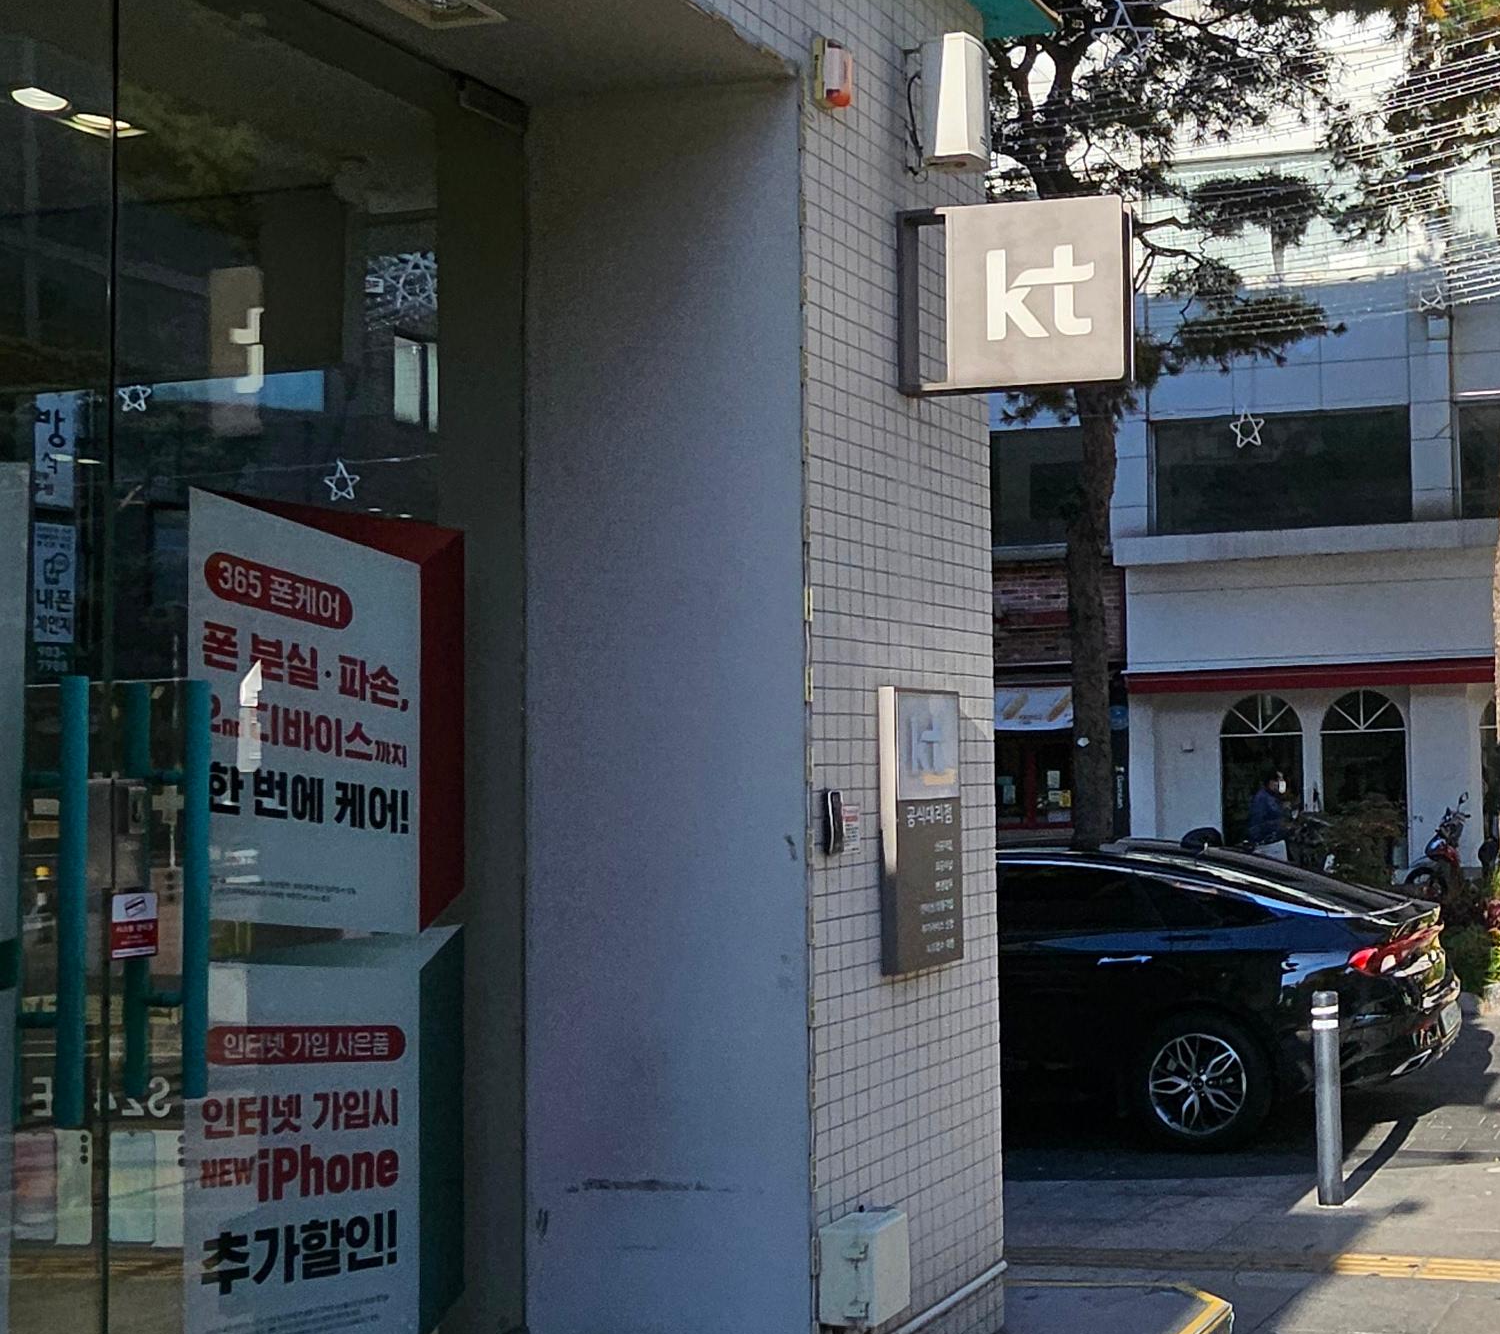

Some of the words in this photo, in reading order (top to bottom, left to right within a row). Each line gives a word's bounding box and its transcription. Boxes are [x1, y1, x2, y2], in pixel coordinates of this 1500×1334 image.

[986, 243, 1095, 341] kt
[217, 560, 263, 600] 365
[269, 573, 342, 623] 폰케어
[202, 620, 239, 672] 폰
[209, 761, 244, 815] 한
[253, 770, 325, 824] 번에
[334, 780, 410, 835] 케어!
[223, 1031, 286, 1060] 인터넷
[291, 1030, 330, 1058] 가입
[334, 1031, 390, 1058] 사은품
[201, 1094, 302, 1140] 인터넷
[312, 1087, 400, 1132] 가입시
[200, 1155, 257, 1190] NEW
[257, 1144, 400, 1203] iPhone
[200, 1209, 399, 1296] 추가할인!
